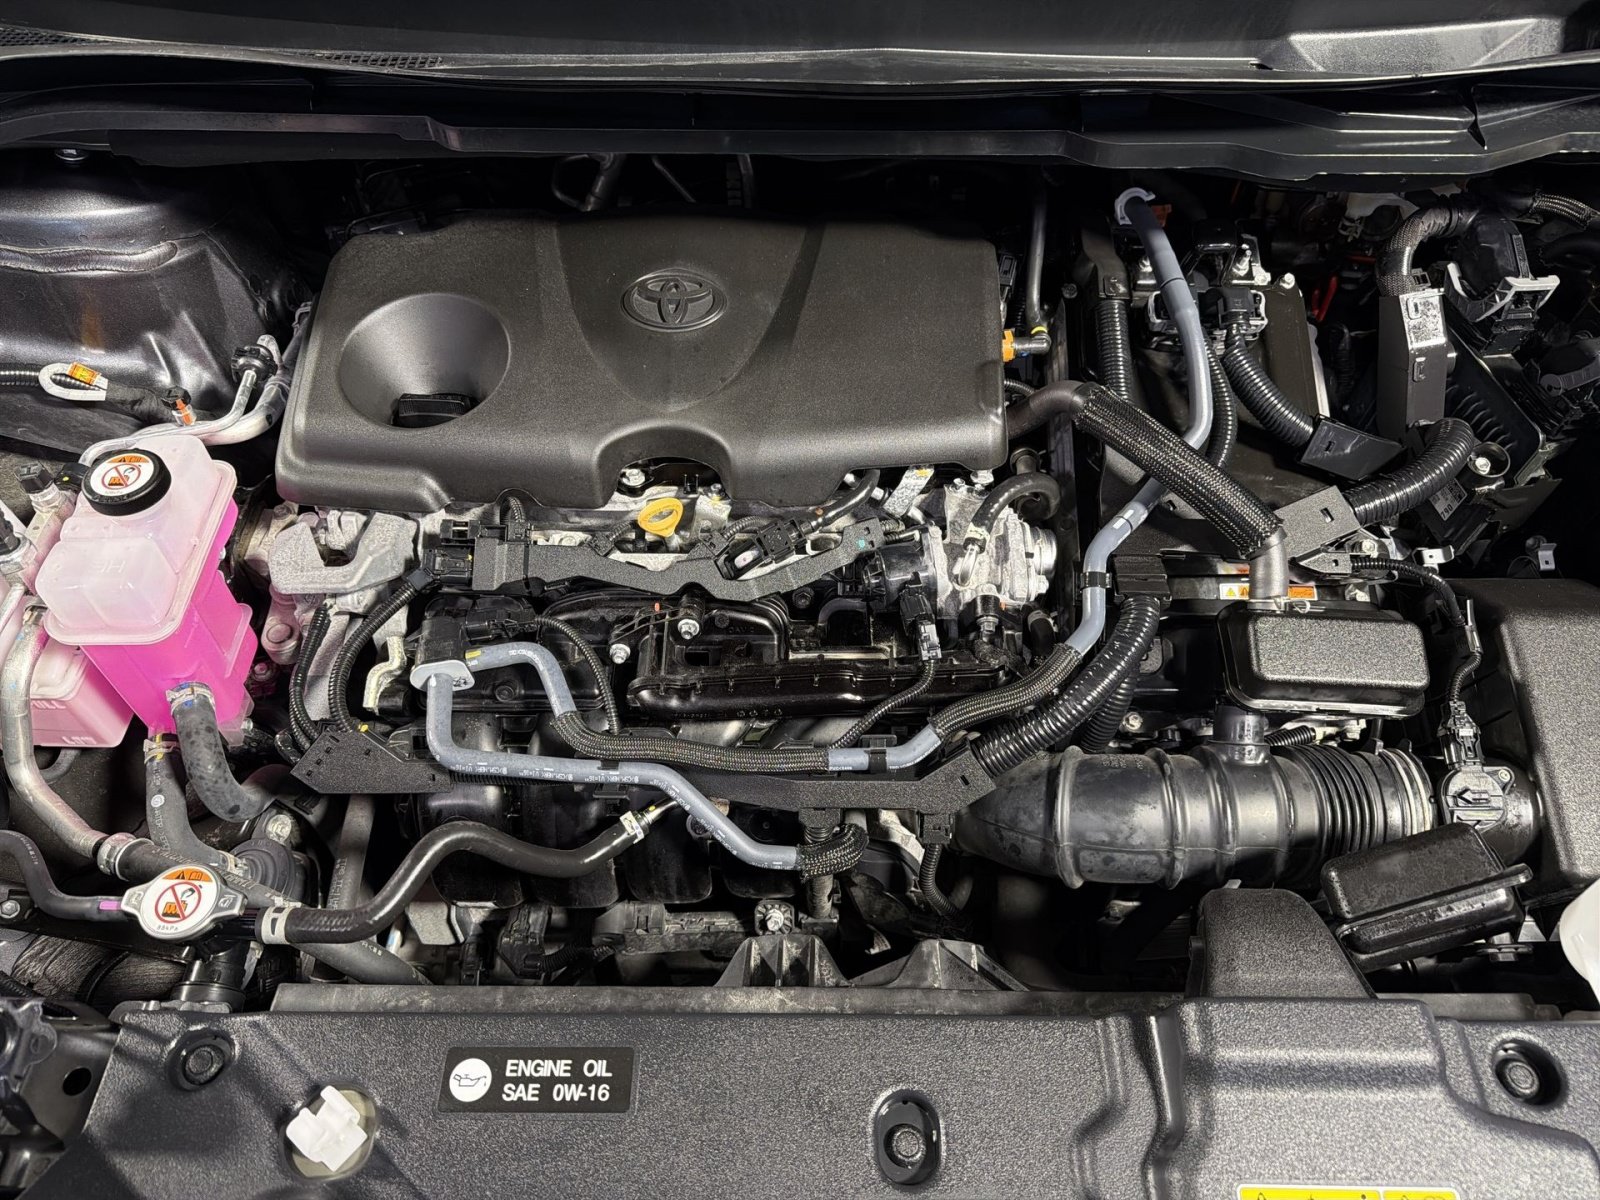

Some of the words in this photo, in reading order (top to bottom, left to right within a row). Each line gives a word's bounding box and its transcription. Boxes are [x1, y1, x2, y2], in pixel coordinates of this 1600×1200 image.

[505, 1059, 572, 1077] ENGINE
[583, 1059, 613, 1077] OIL
[502, 1083, 540, 1101] SAE
[552, 1083, 610, 1101] 0W-16
